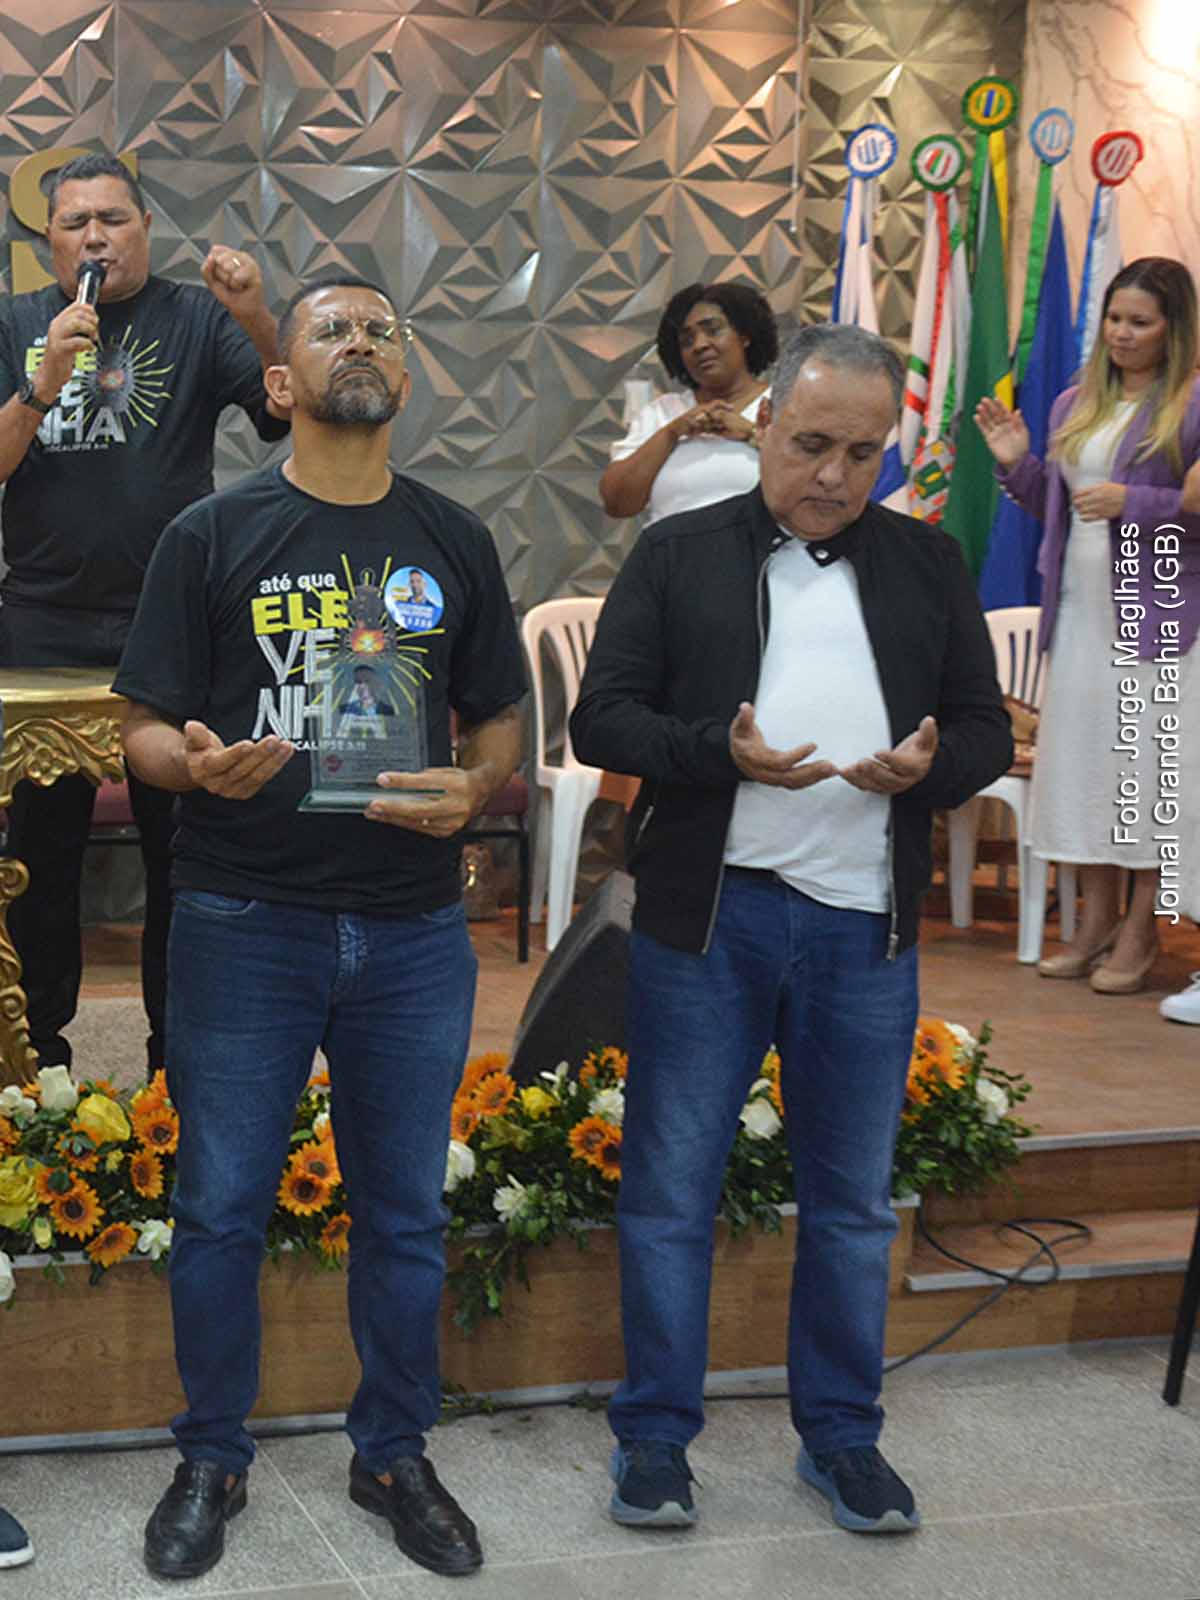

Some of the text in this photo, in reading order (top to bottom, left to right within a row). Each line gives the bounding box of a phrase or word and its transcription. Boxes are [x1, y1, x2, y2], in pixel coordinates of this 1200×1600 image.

[25, 347, 97, 372] EE
[259, 571, 336, 594] até que
[251, 590, 350, 636] ELE
[256, 627, 335, 685] VE
